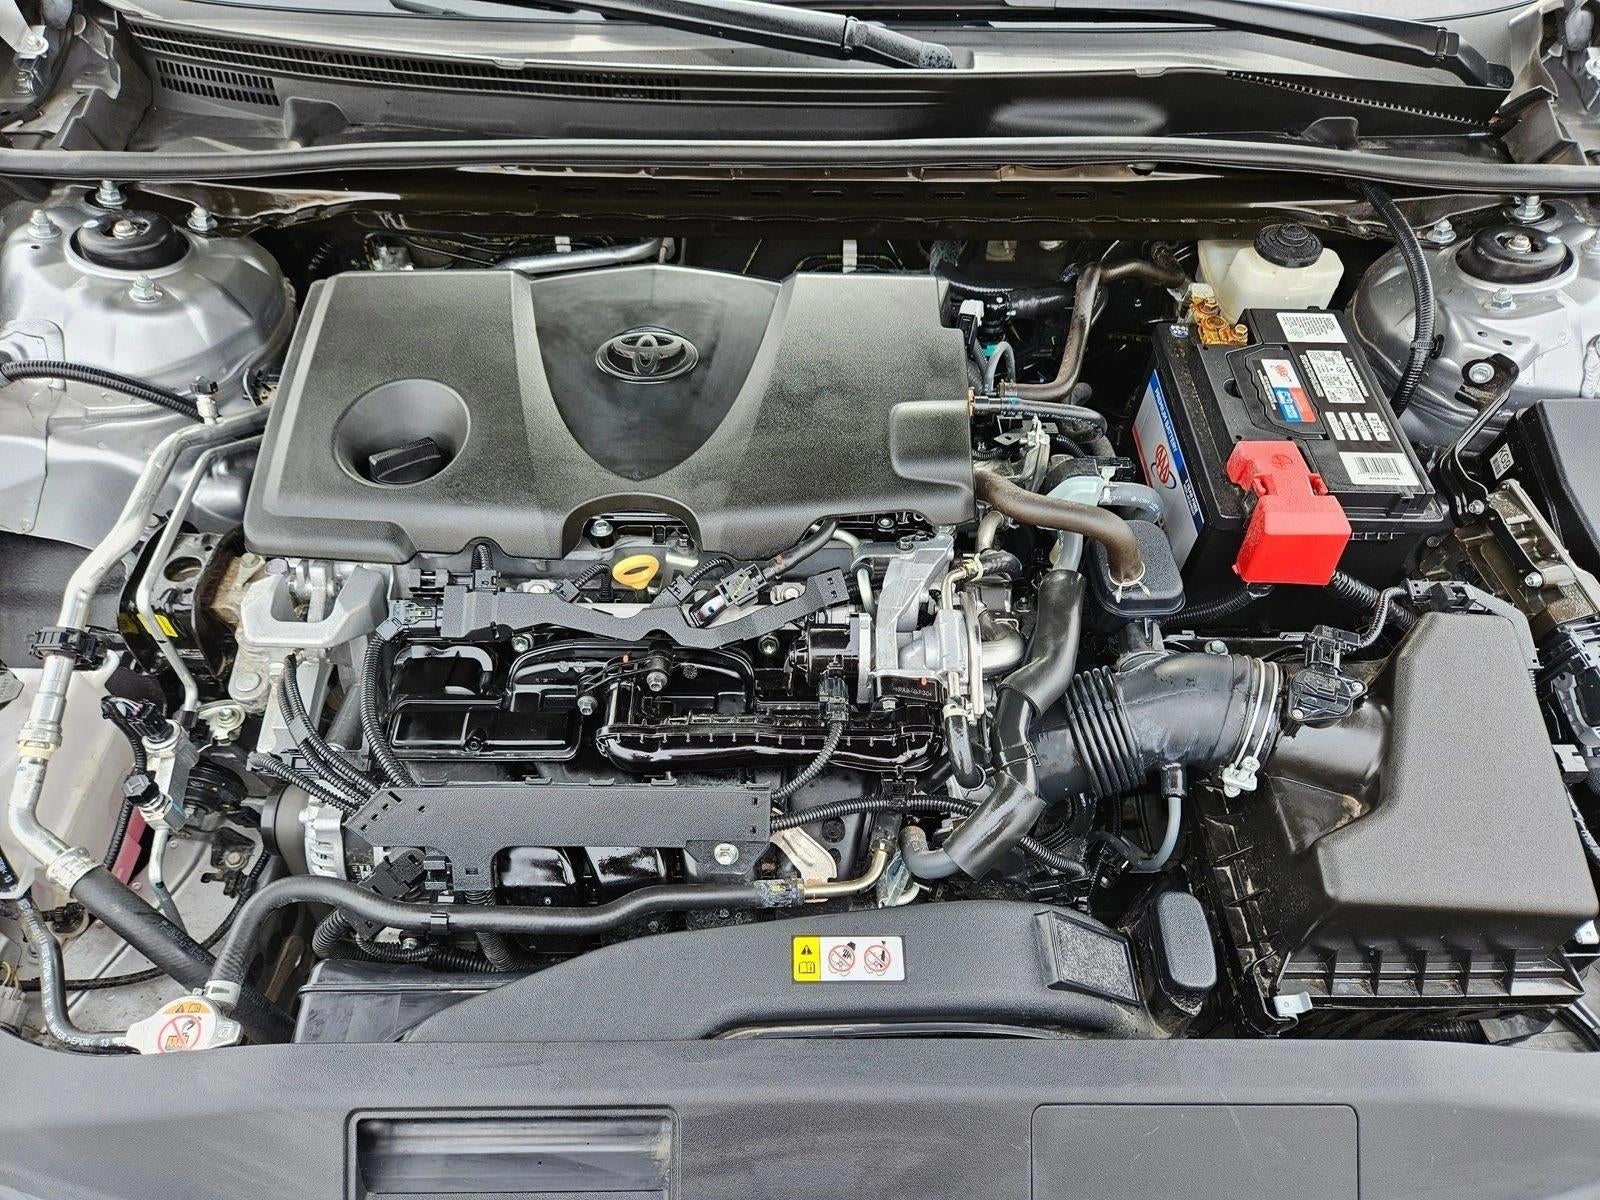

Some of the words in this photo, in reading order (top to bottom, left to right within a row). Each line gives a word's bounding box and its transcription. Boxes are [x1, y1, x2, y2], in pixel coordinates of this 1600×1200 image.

[1154, 387, 1168, 423] PREMIUM
[1164, 420, 1177, 453] BATTERY
[1156, 445, 1169, 483] AAA
[50, 1024, 67, 1042] WATER
